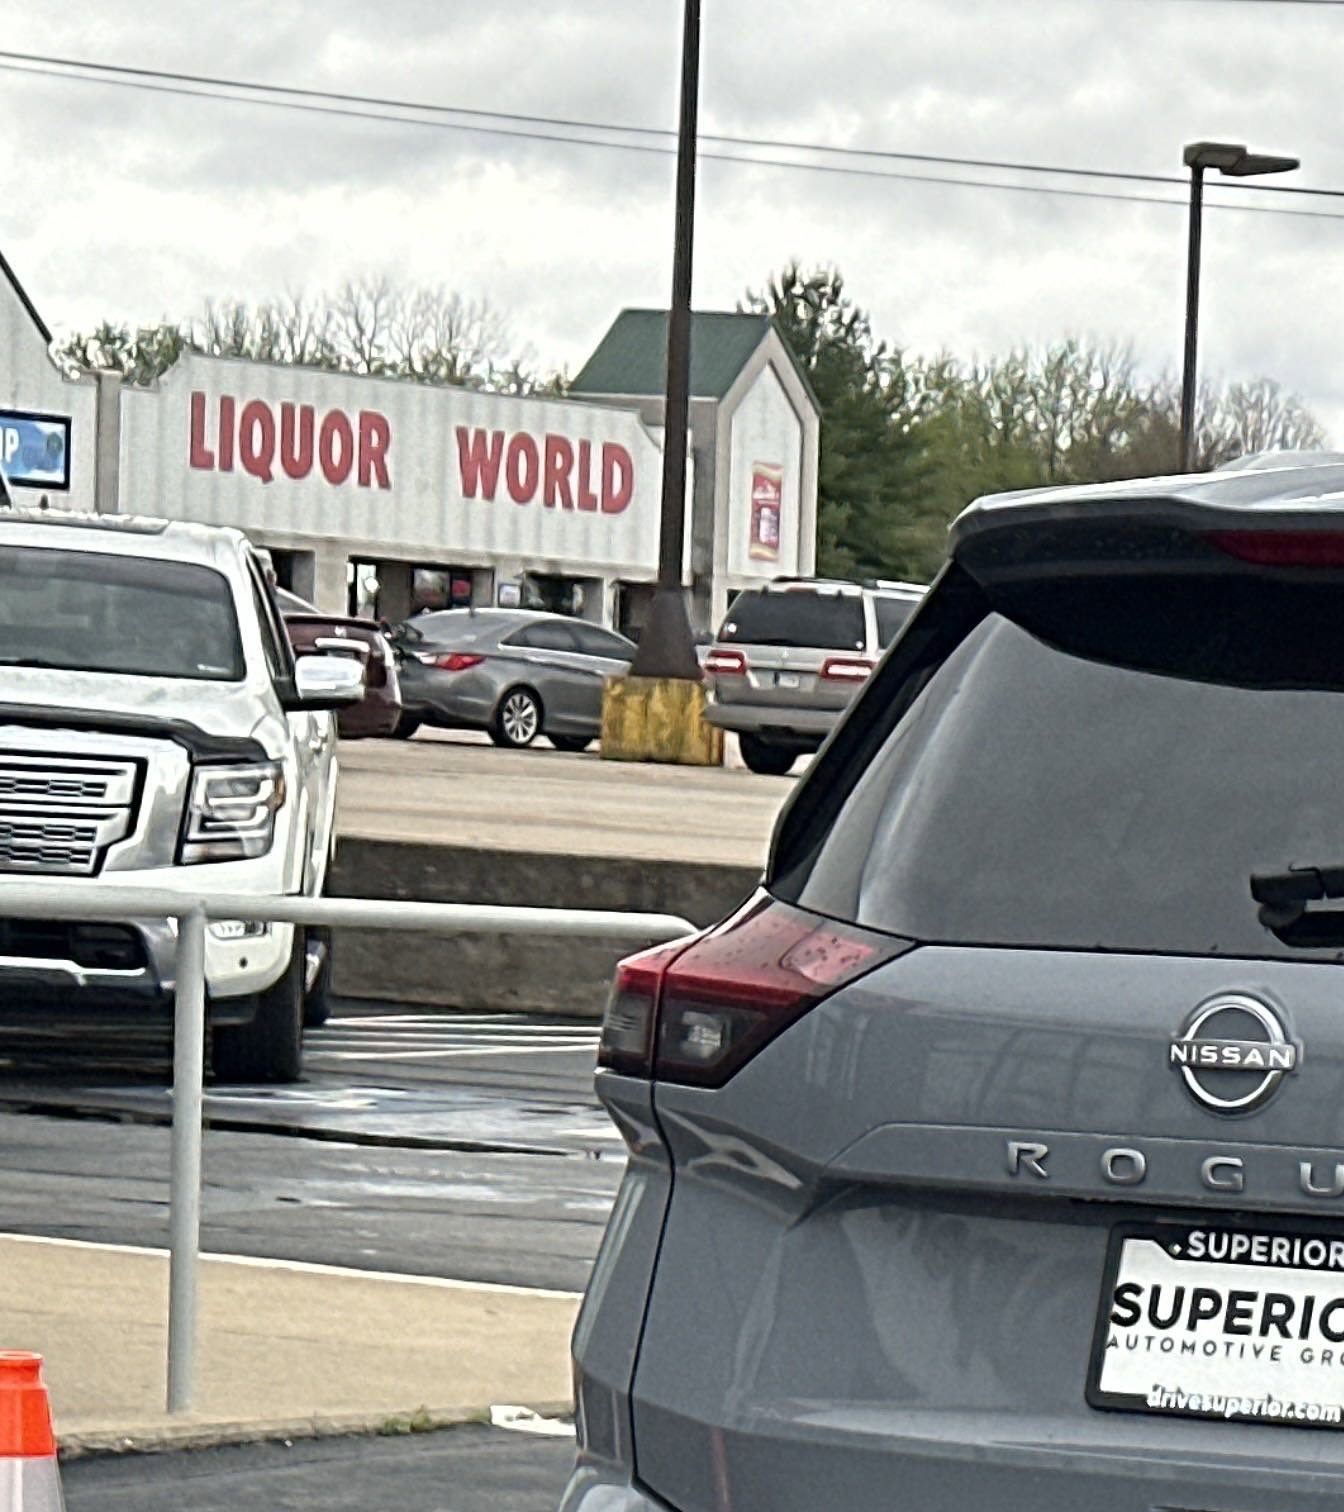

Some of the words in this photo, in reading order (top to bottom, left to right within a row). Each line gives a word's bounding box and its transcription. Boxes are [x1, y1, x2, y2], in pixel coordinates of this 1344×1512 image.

[190, 391, 392, 490] LIQUOR
[456, 426, 634, 514] WORLD
[1170, 1043, 1291, 1068] NISSAN
[1106, 1333, 1283, 1363] AUTOMOTIVE
[1146, 1384, 1342, 1423] drivesuperior.com
